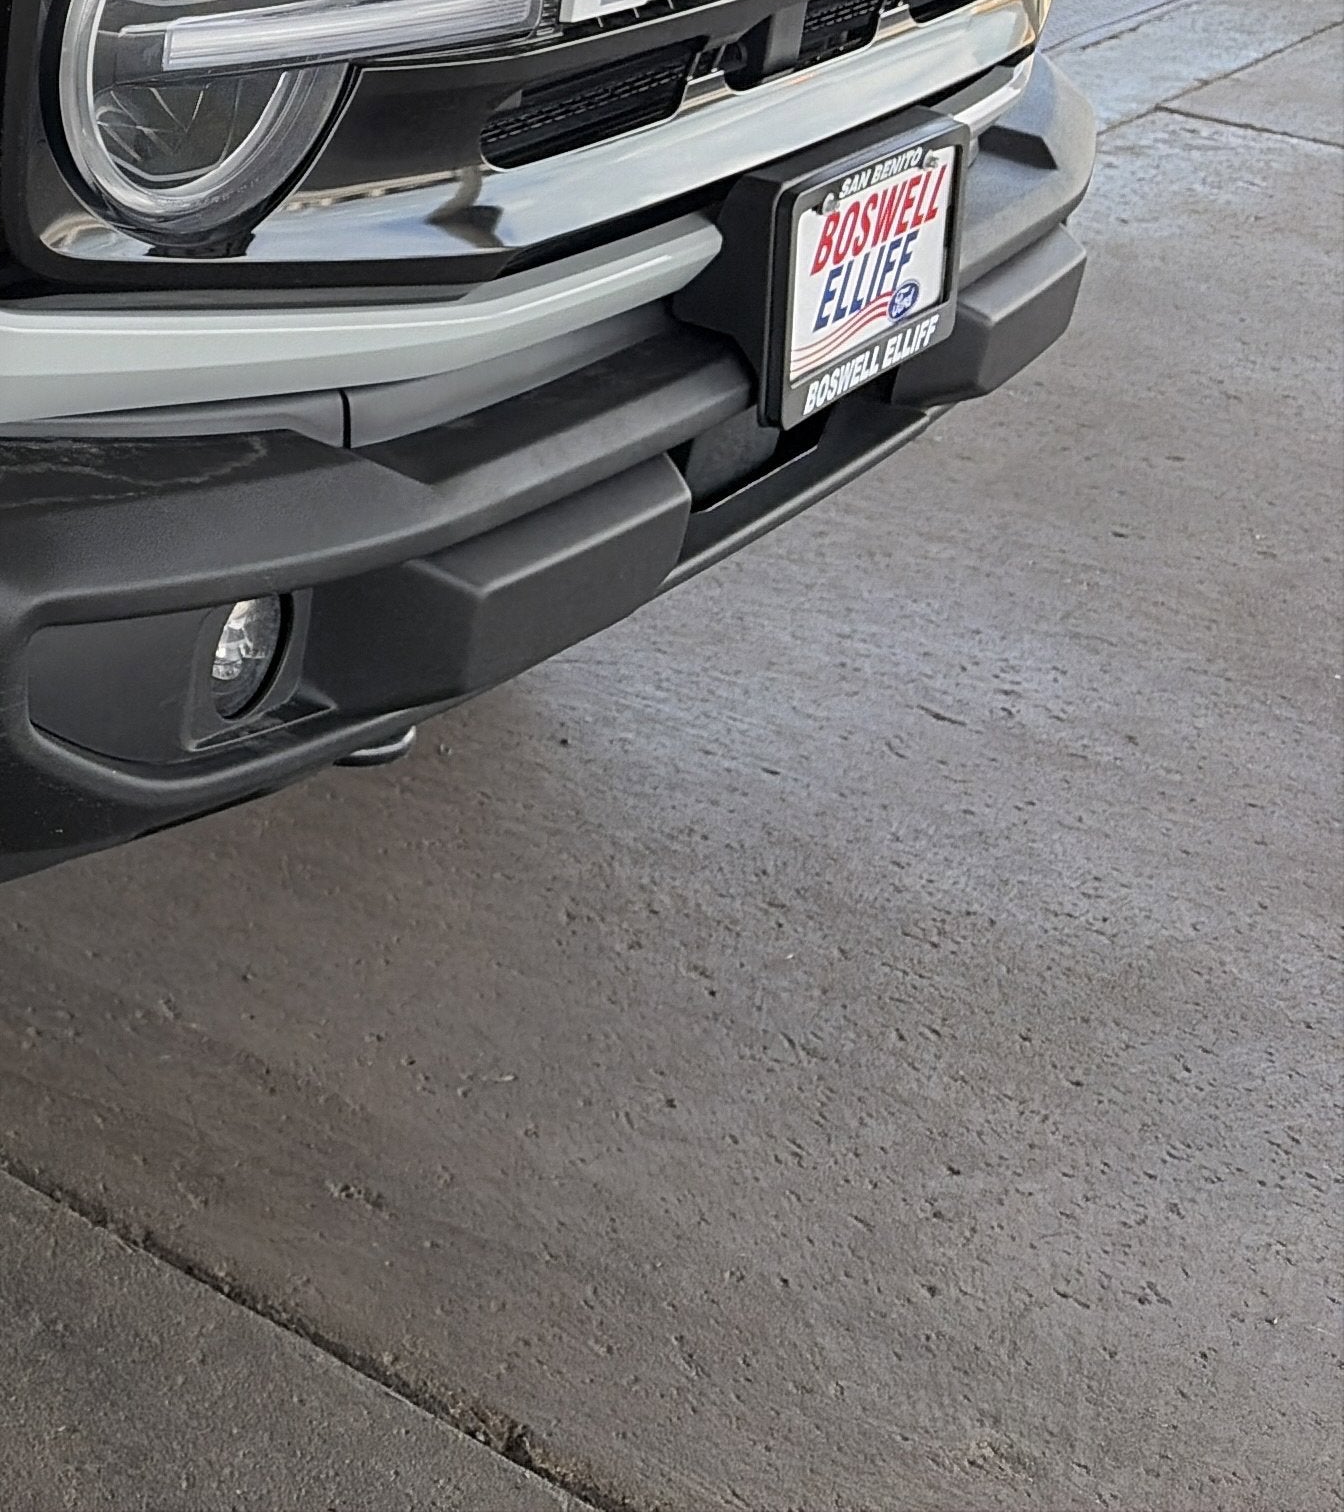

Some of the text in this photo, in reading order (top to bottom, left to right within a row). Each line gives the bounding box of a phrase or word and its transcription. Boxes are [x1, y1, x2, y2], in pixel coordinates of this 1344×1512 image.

[809, 163, 948, 276] BOSWELL
[838, 146, 923, 198] SAN BENITO
[812, 229, 918, 333] ELLIFF
[803, 314, 940, 416] BOSWELL ELLIFF
